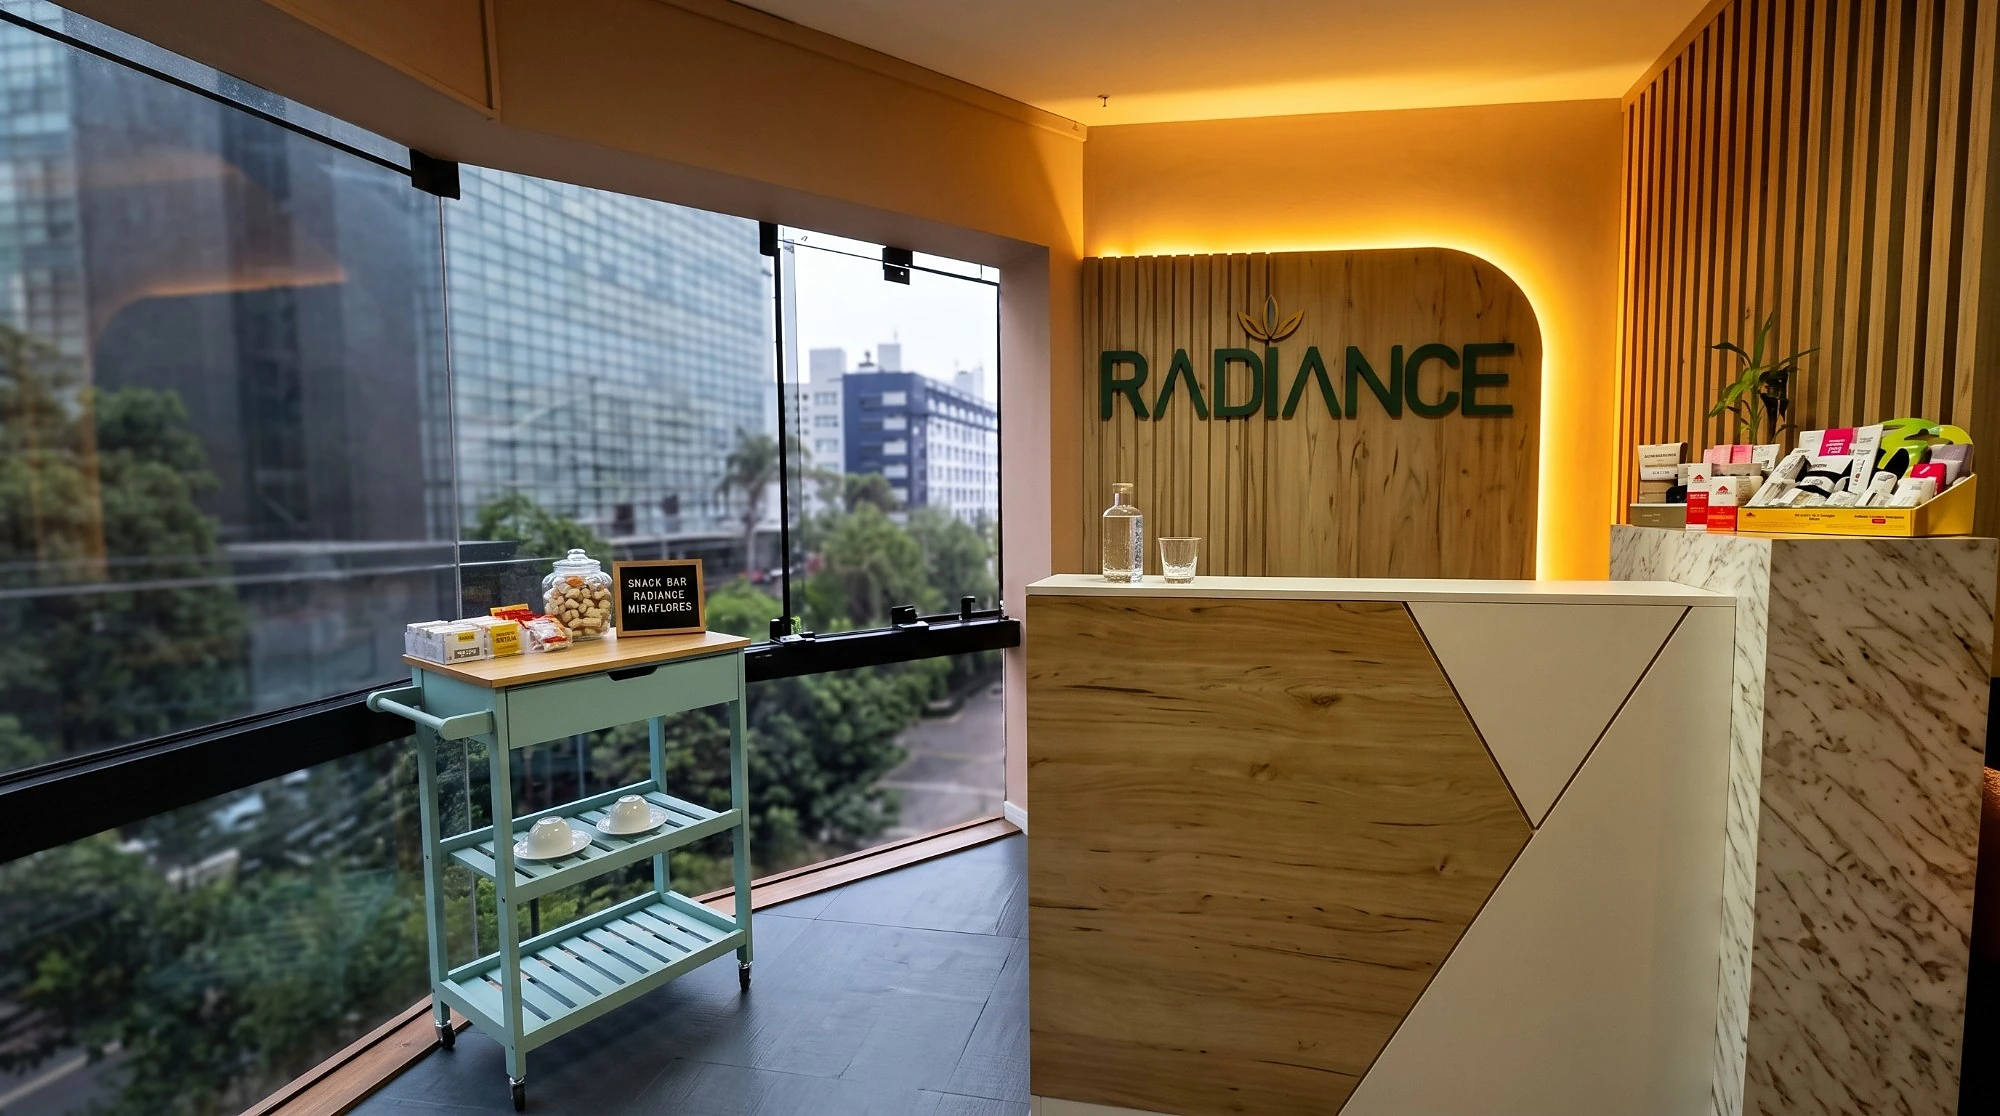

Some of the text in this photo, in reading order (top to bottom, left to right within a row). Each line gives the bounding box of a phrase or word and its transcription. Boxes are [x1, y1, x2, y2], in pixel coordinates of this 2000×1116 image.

[1101, 342, 1516, 421] RADIANCE
[628, 577, 687, 588] SNACK BAR
[633, 589, 685, 601] RADIANCE
[628, 602, 692, 614] MIRAFLORES
